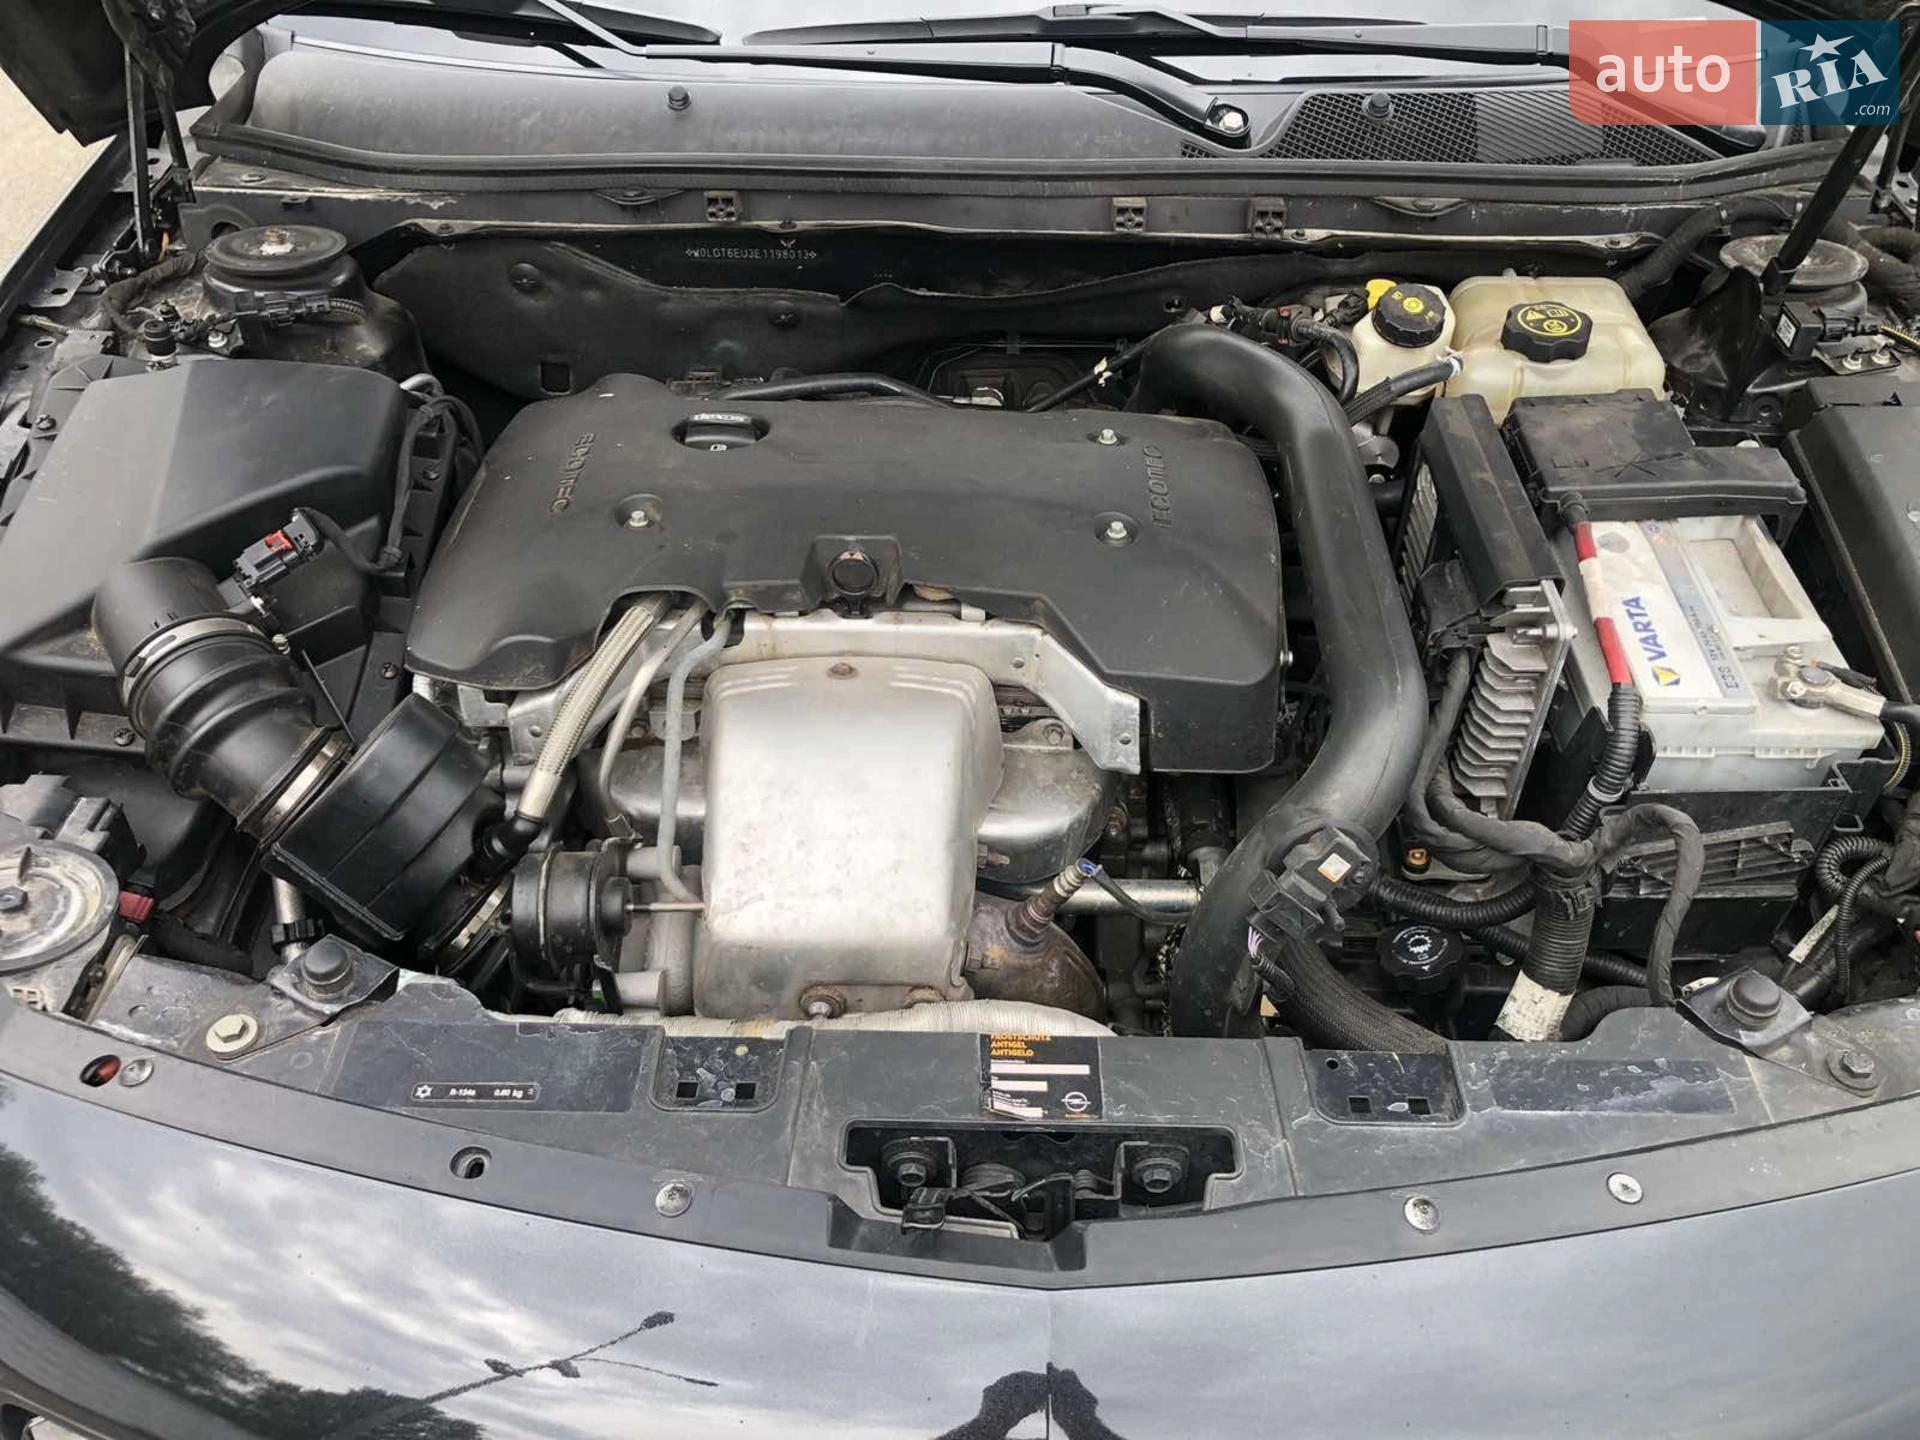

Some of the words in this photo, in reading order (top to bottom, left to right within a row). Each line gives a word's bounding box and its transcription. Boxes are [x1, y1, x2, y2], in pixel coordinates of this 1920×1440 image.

[1143, 445, 1172, 528] ECOTEC
[1622, 596, 1668, 661] VARTA
[990, 1041, 1027, 1049] ANTIGEL
[990, 1048, 1034, 1057] ANTIGELO
[512, 1089, 523, 1098] kg
